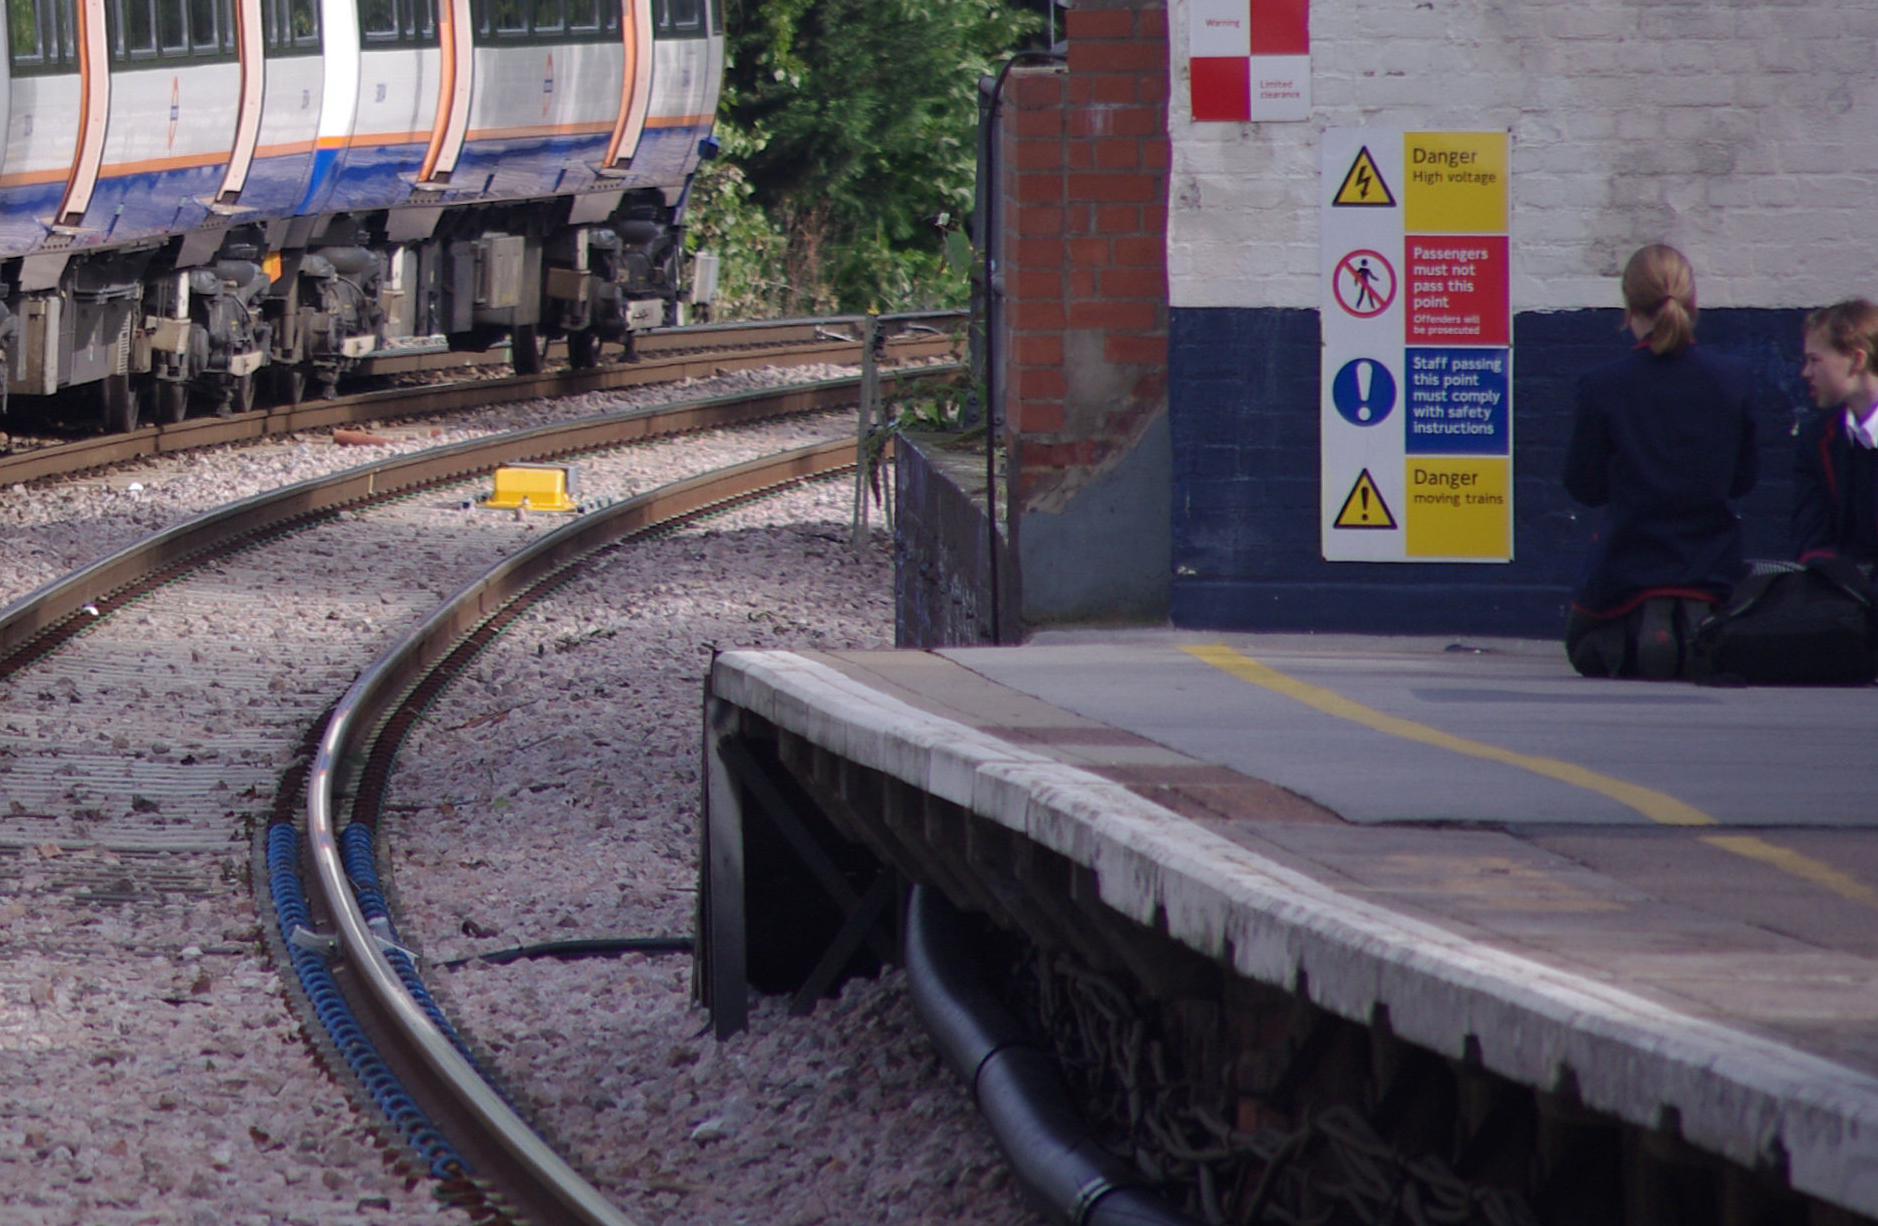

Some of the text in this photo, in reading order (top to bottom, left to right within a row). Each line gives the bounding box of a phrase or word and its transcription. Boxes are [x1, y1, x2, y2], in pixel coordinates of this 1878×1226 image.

[1205, 19, 1241, 29] Warning
[1260, 80, 1293, 89] Limited
[1260, 90, 1300, 99] clearance
[1413, 147, 1478, 168] Danger
[1413, 171, 1497, 185] High voltage
[1413, 246, 1489, 262] Passengers
[1413, 265, 1476, 276] must not
[1413, 280, 1474, 294] pass this
[1413, 295, 1450, 310] point
[1413, 315, 1480, 324] Offenders will
[1413, 326, 1480, 336] be prosecuted
[1413, 357, 1502, 373] Staff passing
[1413, 374, 1480, 389] this point
[1413, 389, 1501, 405] must comply
[1413, 405, 1492, 421] with safety
[1413, 421, 1494, 434] instructions
[1414, 468, 1478, 489] Danger
[1414, 493, 1504, 507] moving trains
